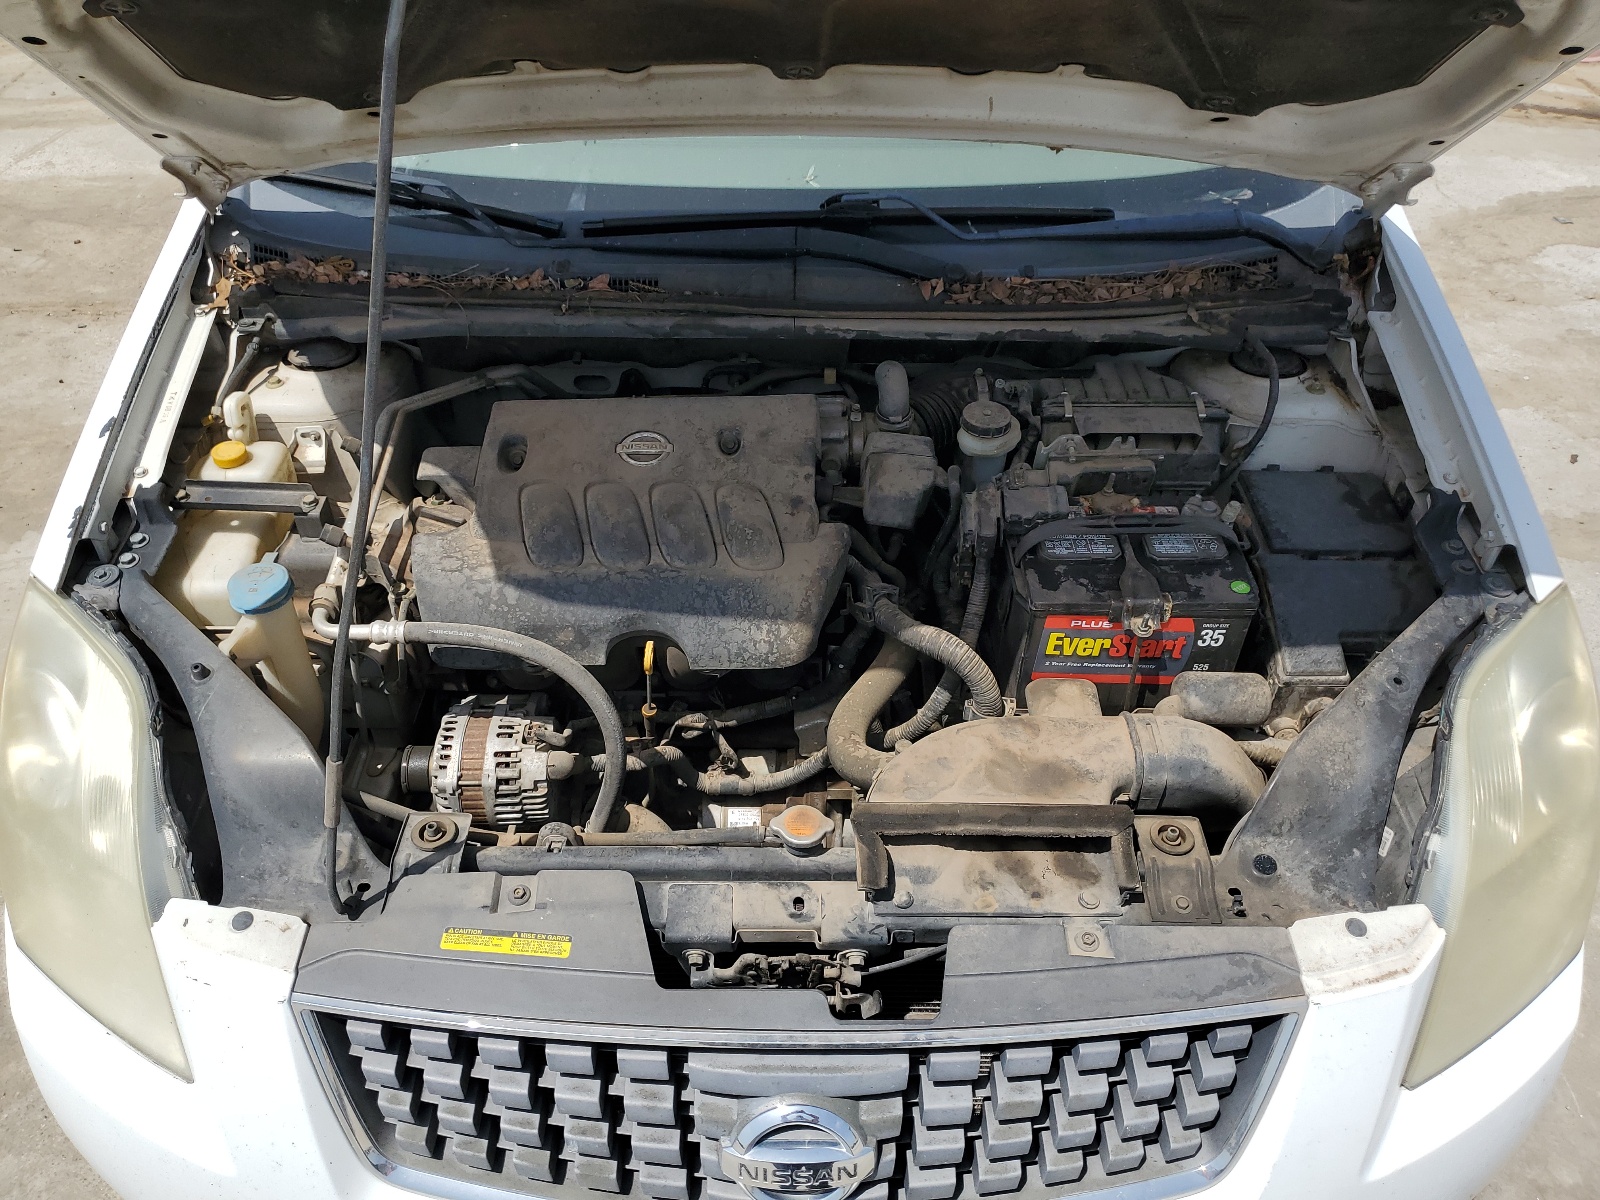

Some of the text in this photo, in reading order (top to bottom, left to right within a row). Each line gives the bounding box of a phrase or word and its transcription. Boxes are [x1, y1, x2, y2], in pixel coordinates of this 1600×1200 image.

[1070, 620, 1114, 628] PLUS
[1197, 629, 1227, 647] 35
[1192, 663, 1210, 671] 525
[547, 934, 571, 942] GARDE
[738, 1161, 859, 1187] NISSAN
